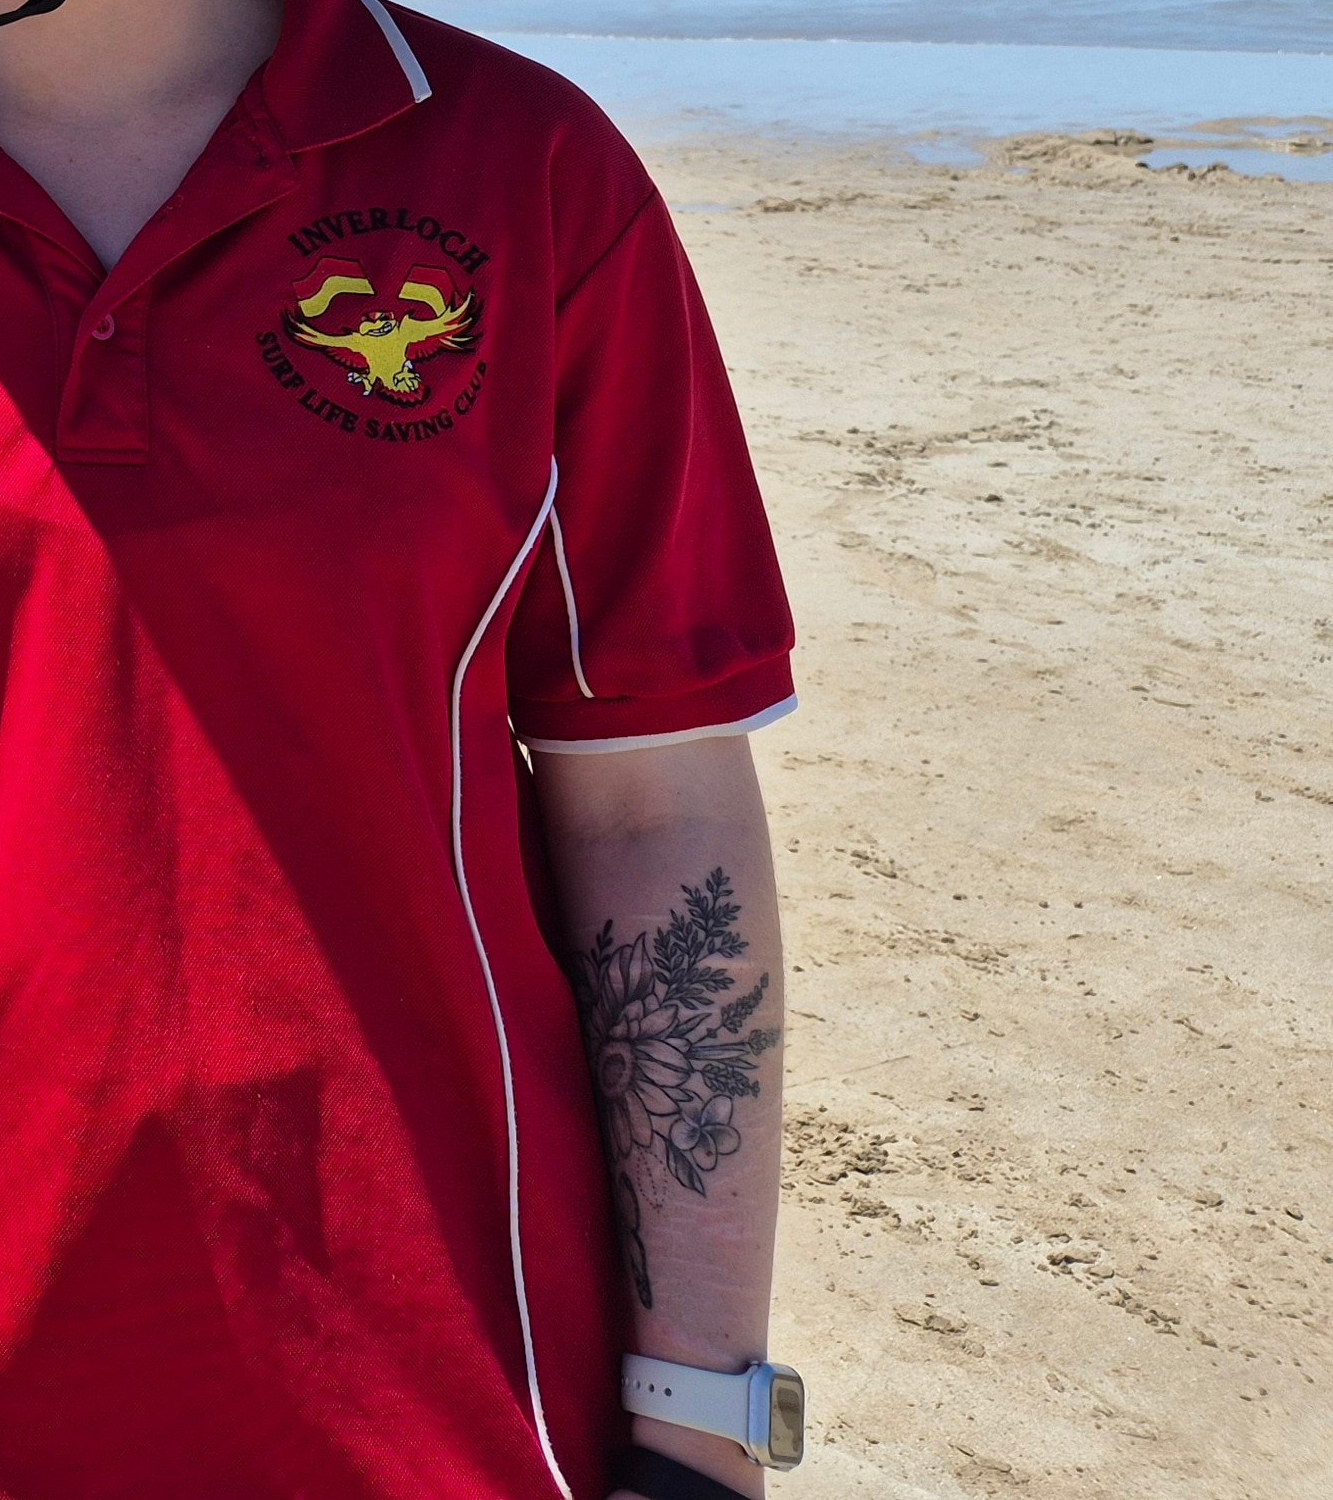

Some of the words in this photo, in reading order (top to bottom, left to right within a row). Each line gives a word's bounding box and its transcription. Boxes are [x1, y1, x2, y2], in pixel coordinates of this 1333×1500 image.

[287, 207, 491, 275] INVERLOCH
[256, 331, 305, 391] SURF
[298, 388, 359, 433] LIFE
[365, 408, 455, 442] SAVING
